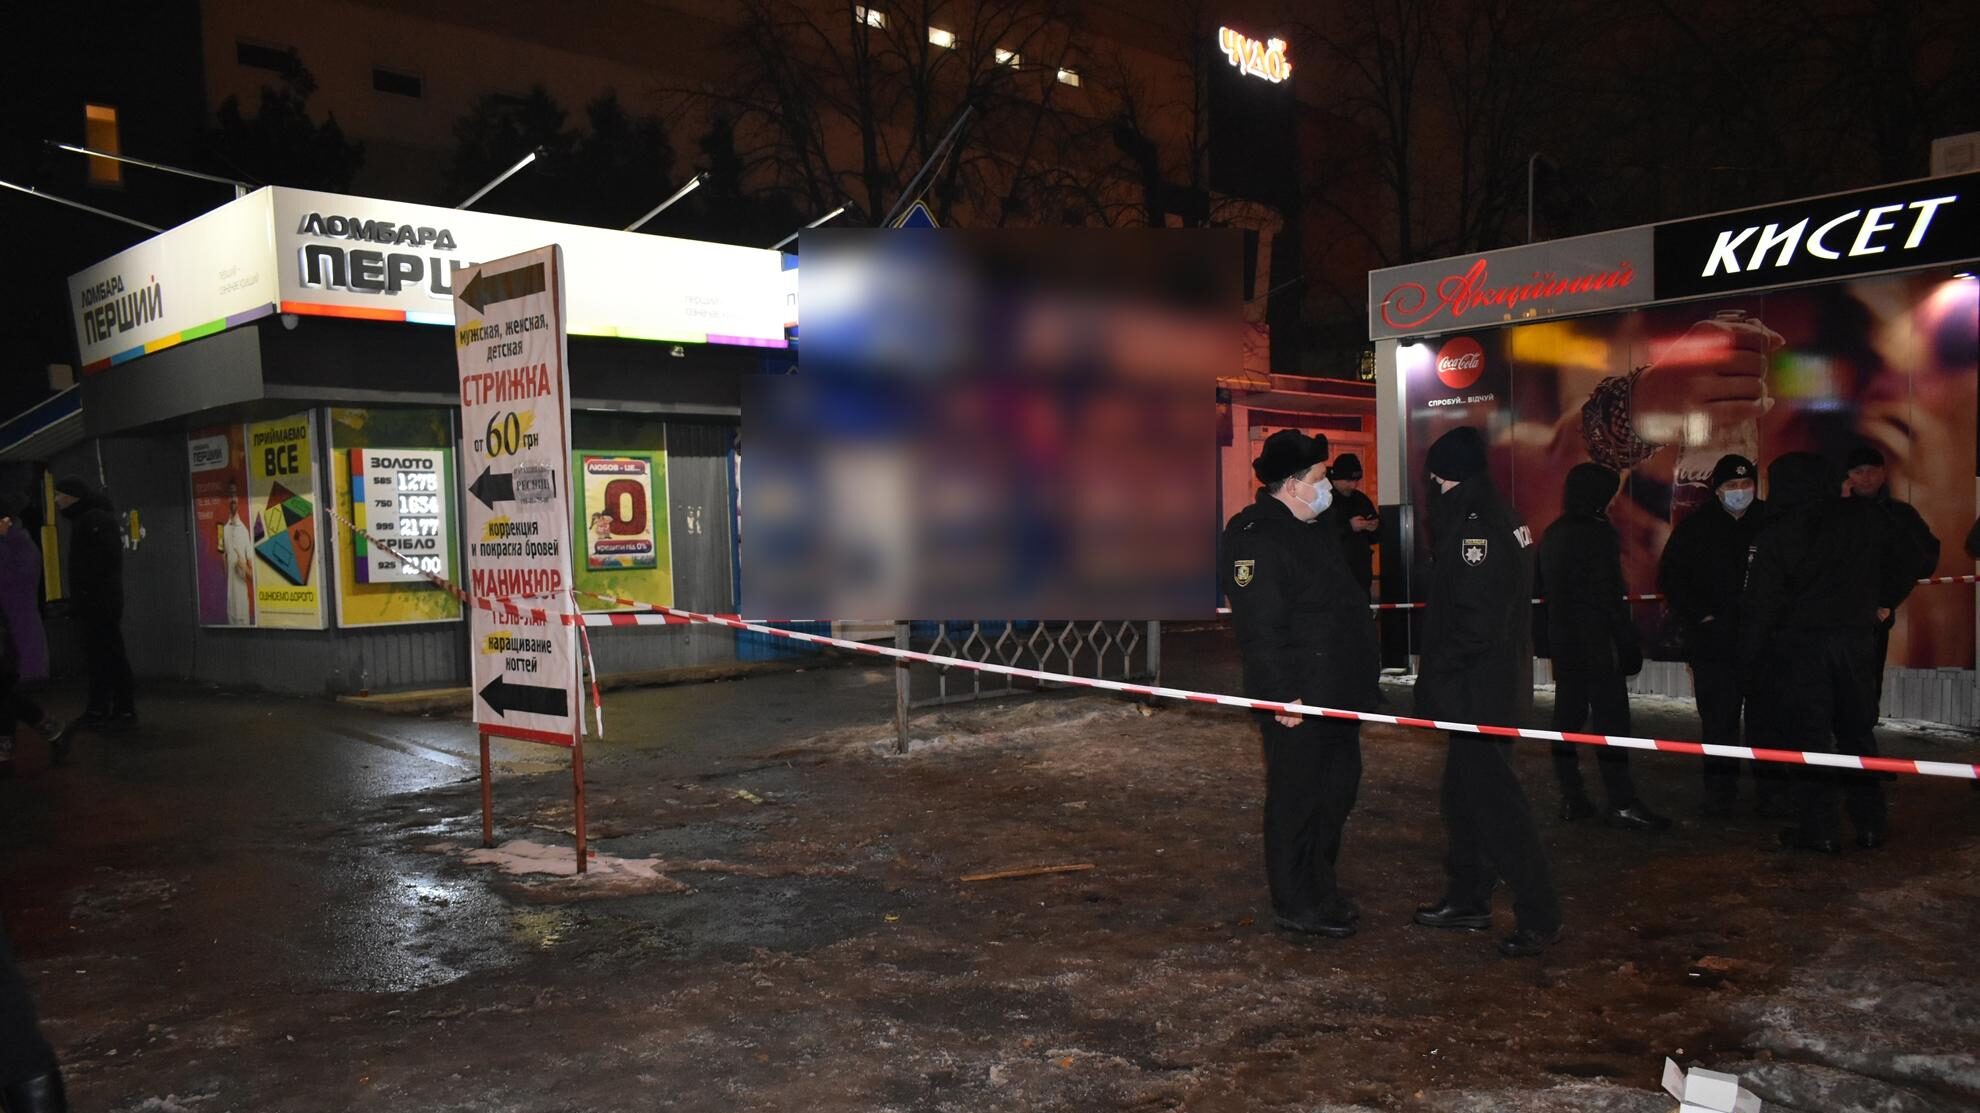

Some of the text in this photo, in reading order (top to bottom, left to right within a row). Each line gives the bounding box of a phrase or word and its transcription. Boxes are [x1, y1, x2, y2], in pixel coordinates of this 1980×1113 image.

[298, 212, 457, 249] ЛОМБАРД
[1701, 195, 1957, 277] КИСЕТ
[82, 274, 125, 308] ЛОМБАРД
[83, 274, 163, 346] ПЕРШИЙ
[460, 313, 549, 346] мужская, женская,
[487, 341, 523, 362] детская
[462, 363, 551, 407] СТРИЖКА
[474, 411, 539, 457] от 60 грн
[264, 444, 299, 477] ВСЕ
[370, 457, 433, 469] ЗОЛОТО
[373, 476, 392, 485] 585
[375, 499, 392, 508] 750
[376, 522, 394, 531] 999
[489, 521, 538, 538] коррекция
[472, 538, 559, 559] и покраска бровей
[378, 561, 396, 570] 925
[472, 569, 561, 599] МАНИКЮР
[488, 636, 551, 654] наращивание
[506, 657, 537, 672] ногтей
